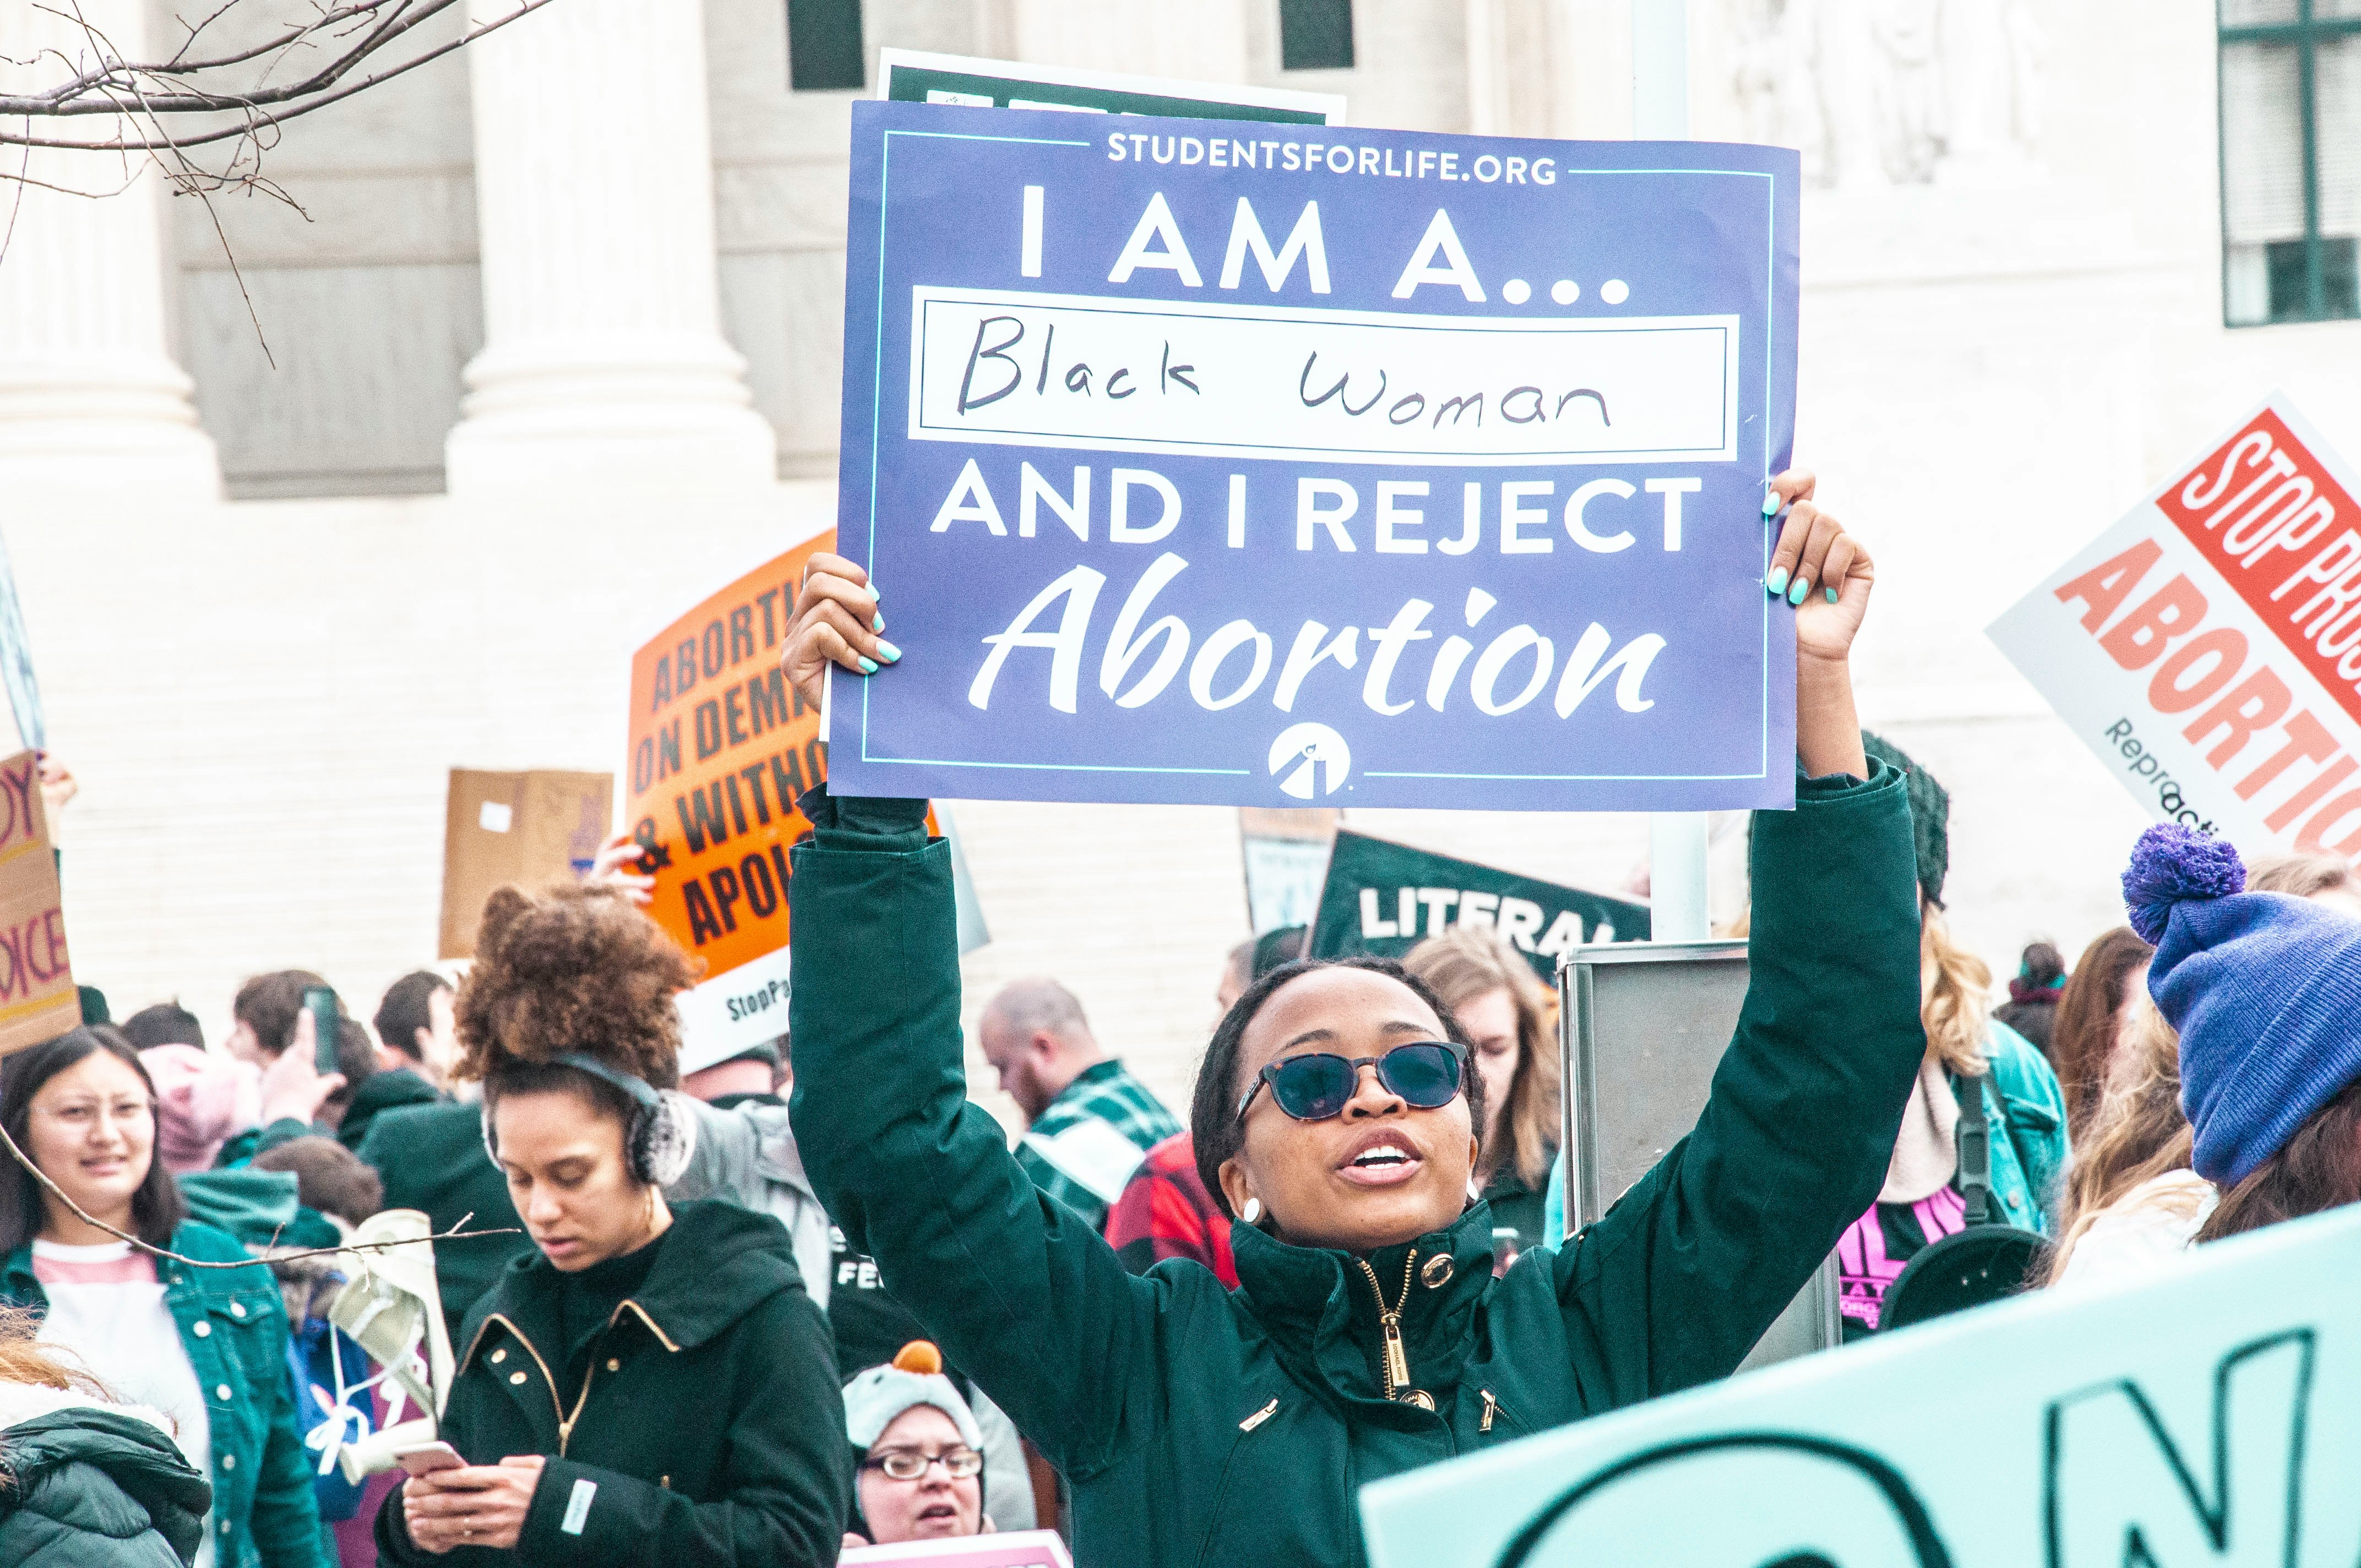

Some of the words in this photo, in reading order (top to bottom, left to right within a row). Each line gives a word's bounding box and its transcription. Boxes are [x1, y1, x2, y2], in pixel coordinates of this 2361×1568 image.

[1107, 132, 1558, 186] STUDENTSFORLIFE.ORG
[1021, 185, 1045, 278] I
[1108, 192, 1332, 294] AM
[1391, 208, 1630, 306] A...
[956, 315, 1201, 417] Black
[1299, 350, 1612, 428] Woman
[929, 458, 1182, 544] AND
[1227, 474, 1247, 548] I
[1296, 477, 1702, 556] REJECT
[2181, 431, 2335, 570] STOP
[652, 574, 806, 712] ABORTI
[967, 552, 1667, 720] Abortion
[635, 722, 682, 794] ON
[634, 816, 672, 875] &
[837, 1261, 884, 1289] FE
